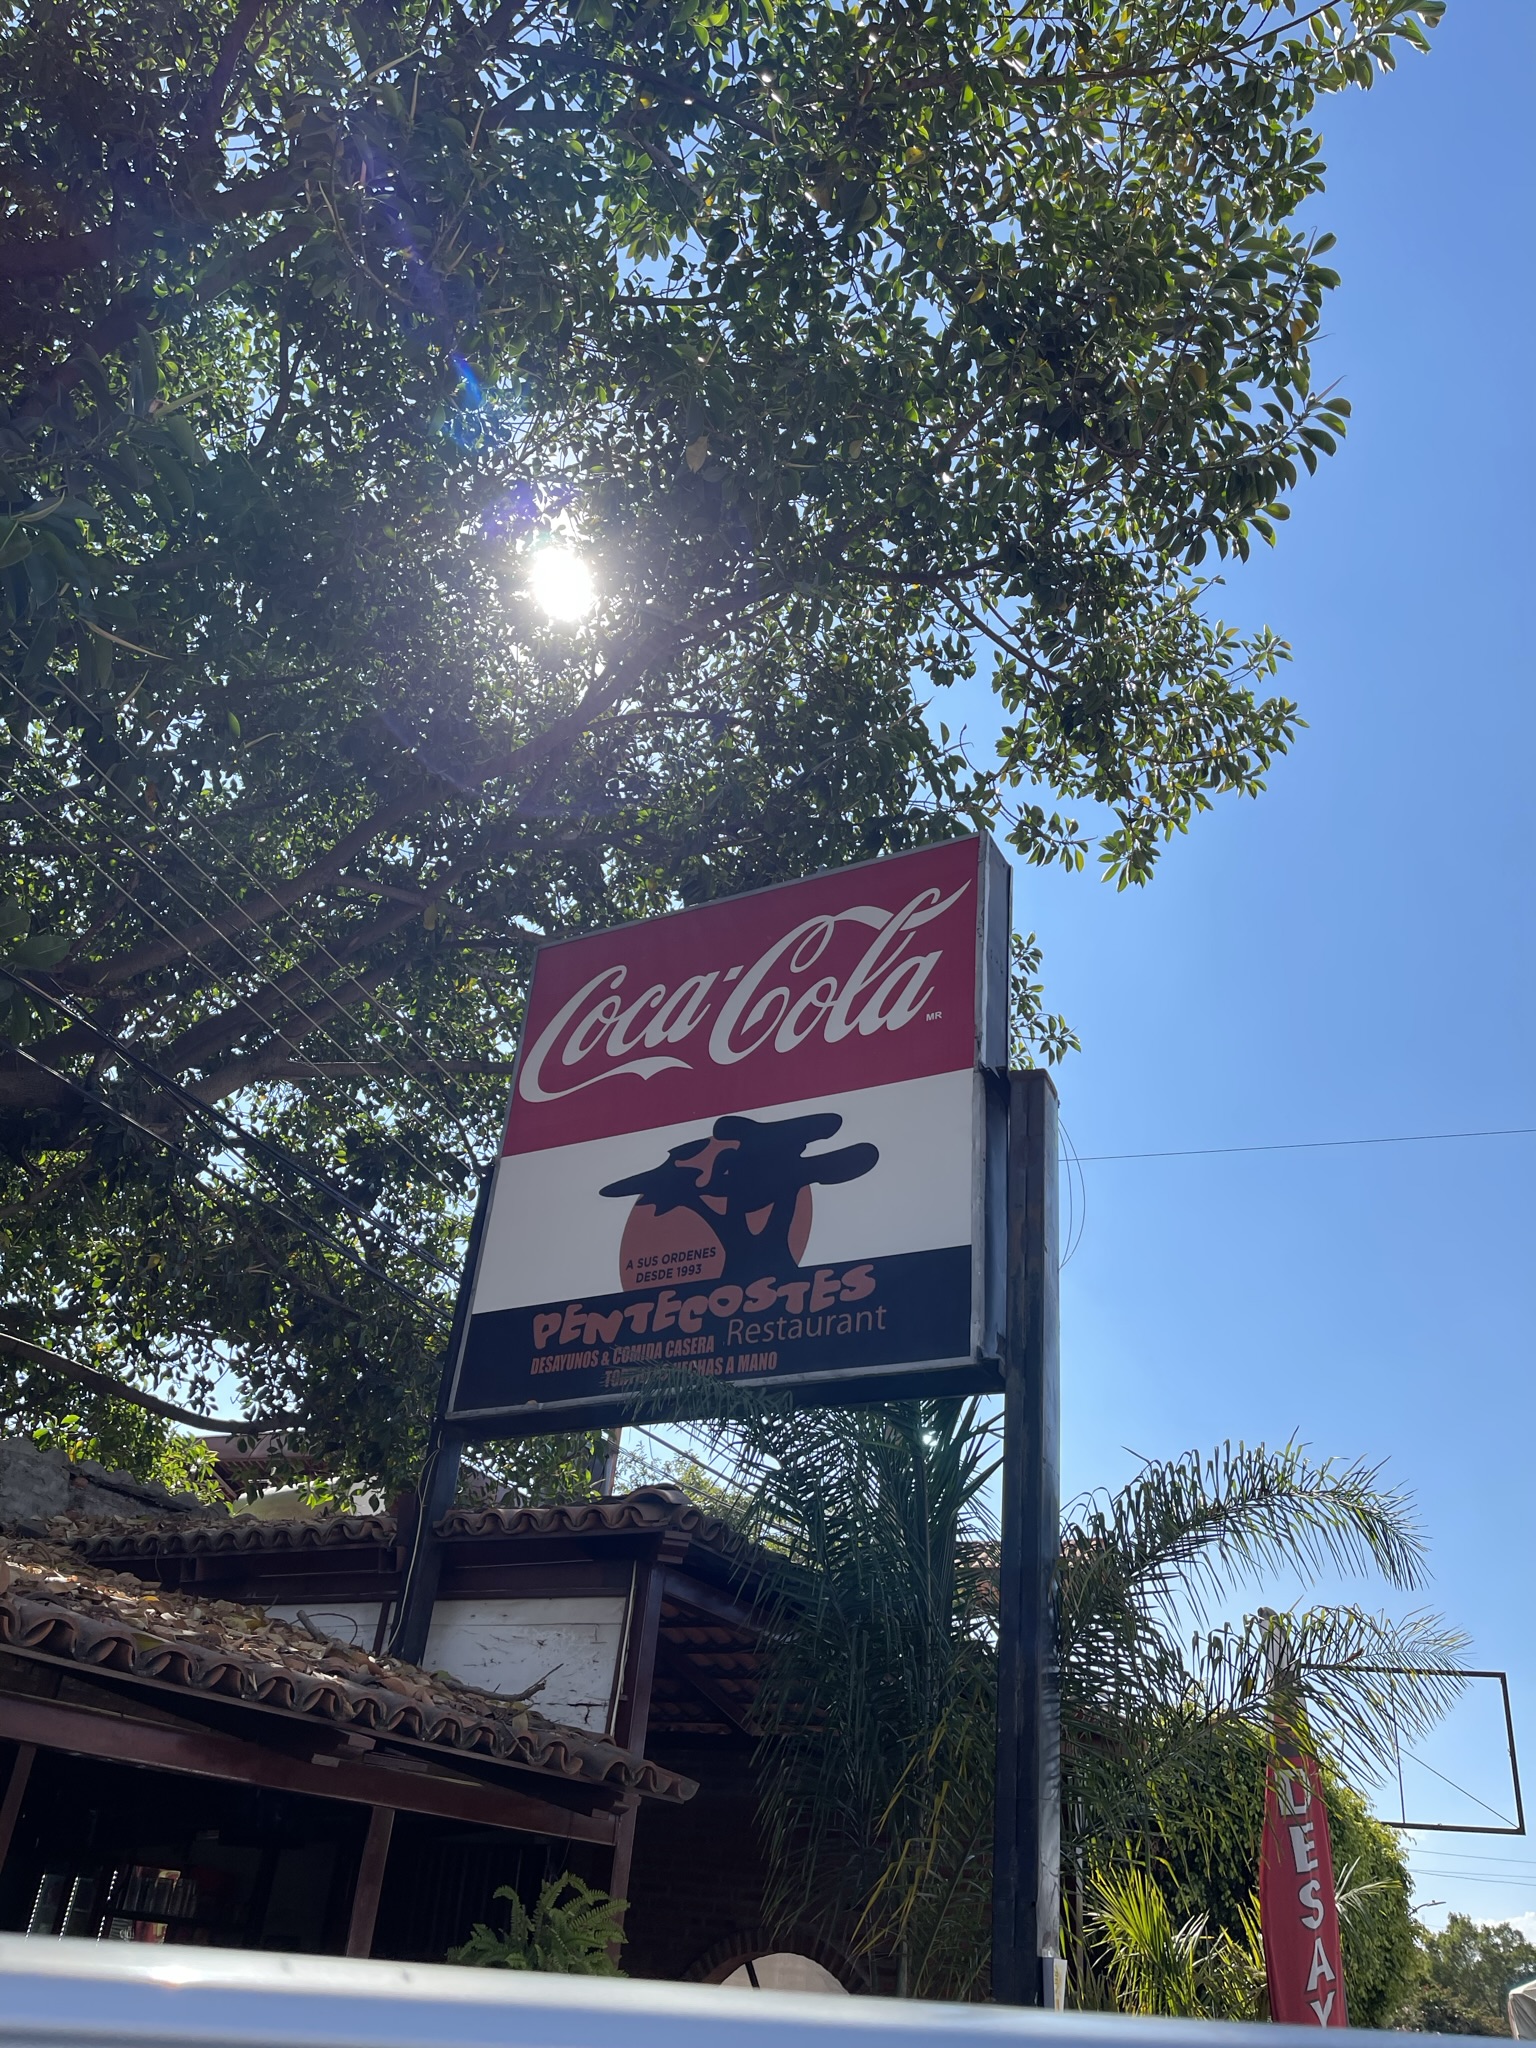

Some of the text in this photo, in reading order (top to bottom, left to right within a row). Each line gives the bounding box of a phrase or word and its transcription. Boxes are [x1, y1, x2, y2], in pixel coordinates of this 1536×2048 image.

[519, 879, 972, 1102] Coca-Cola
[925, 1011, 943, 1022] MR
[626, 1247, 716, 1271] A SUS ORDENES
[635, 1264, 702, 1283] DESDE 1993
[532, 1264, 877, 1349] PENTECOSTES
[726, 1305, 887, 1347] Restaurant
[530, 1335, 715, 1375] DESAYUNOS & COMIDA CASERA
[725, 1355, 734, 1374] A
[737, 1351, 778, 1373] MANO
